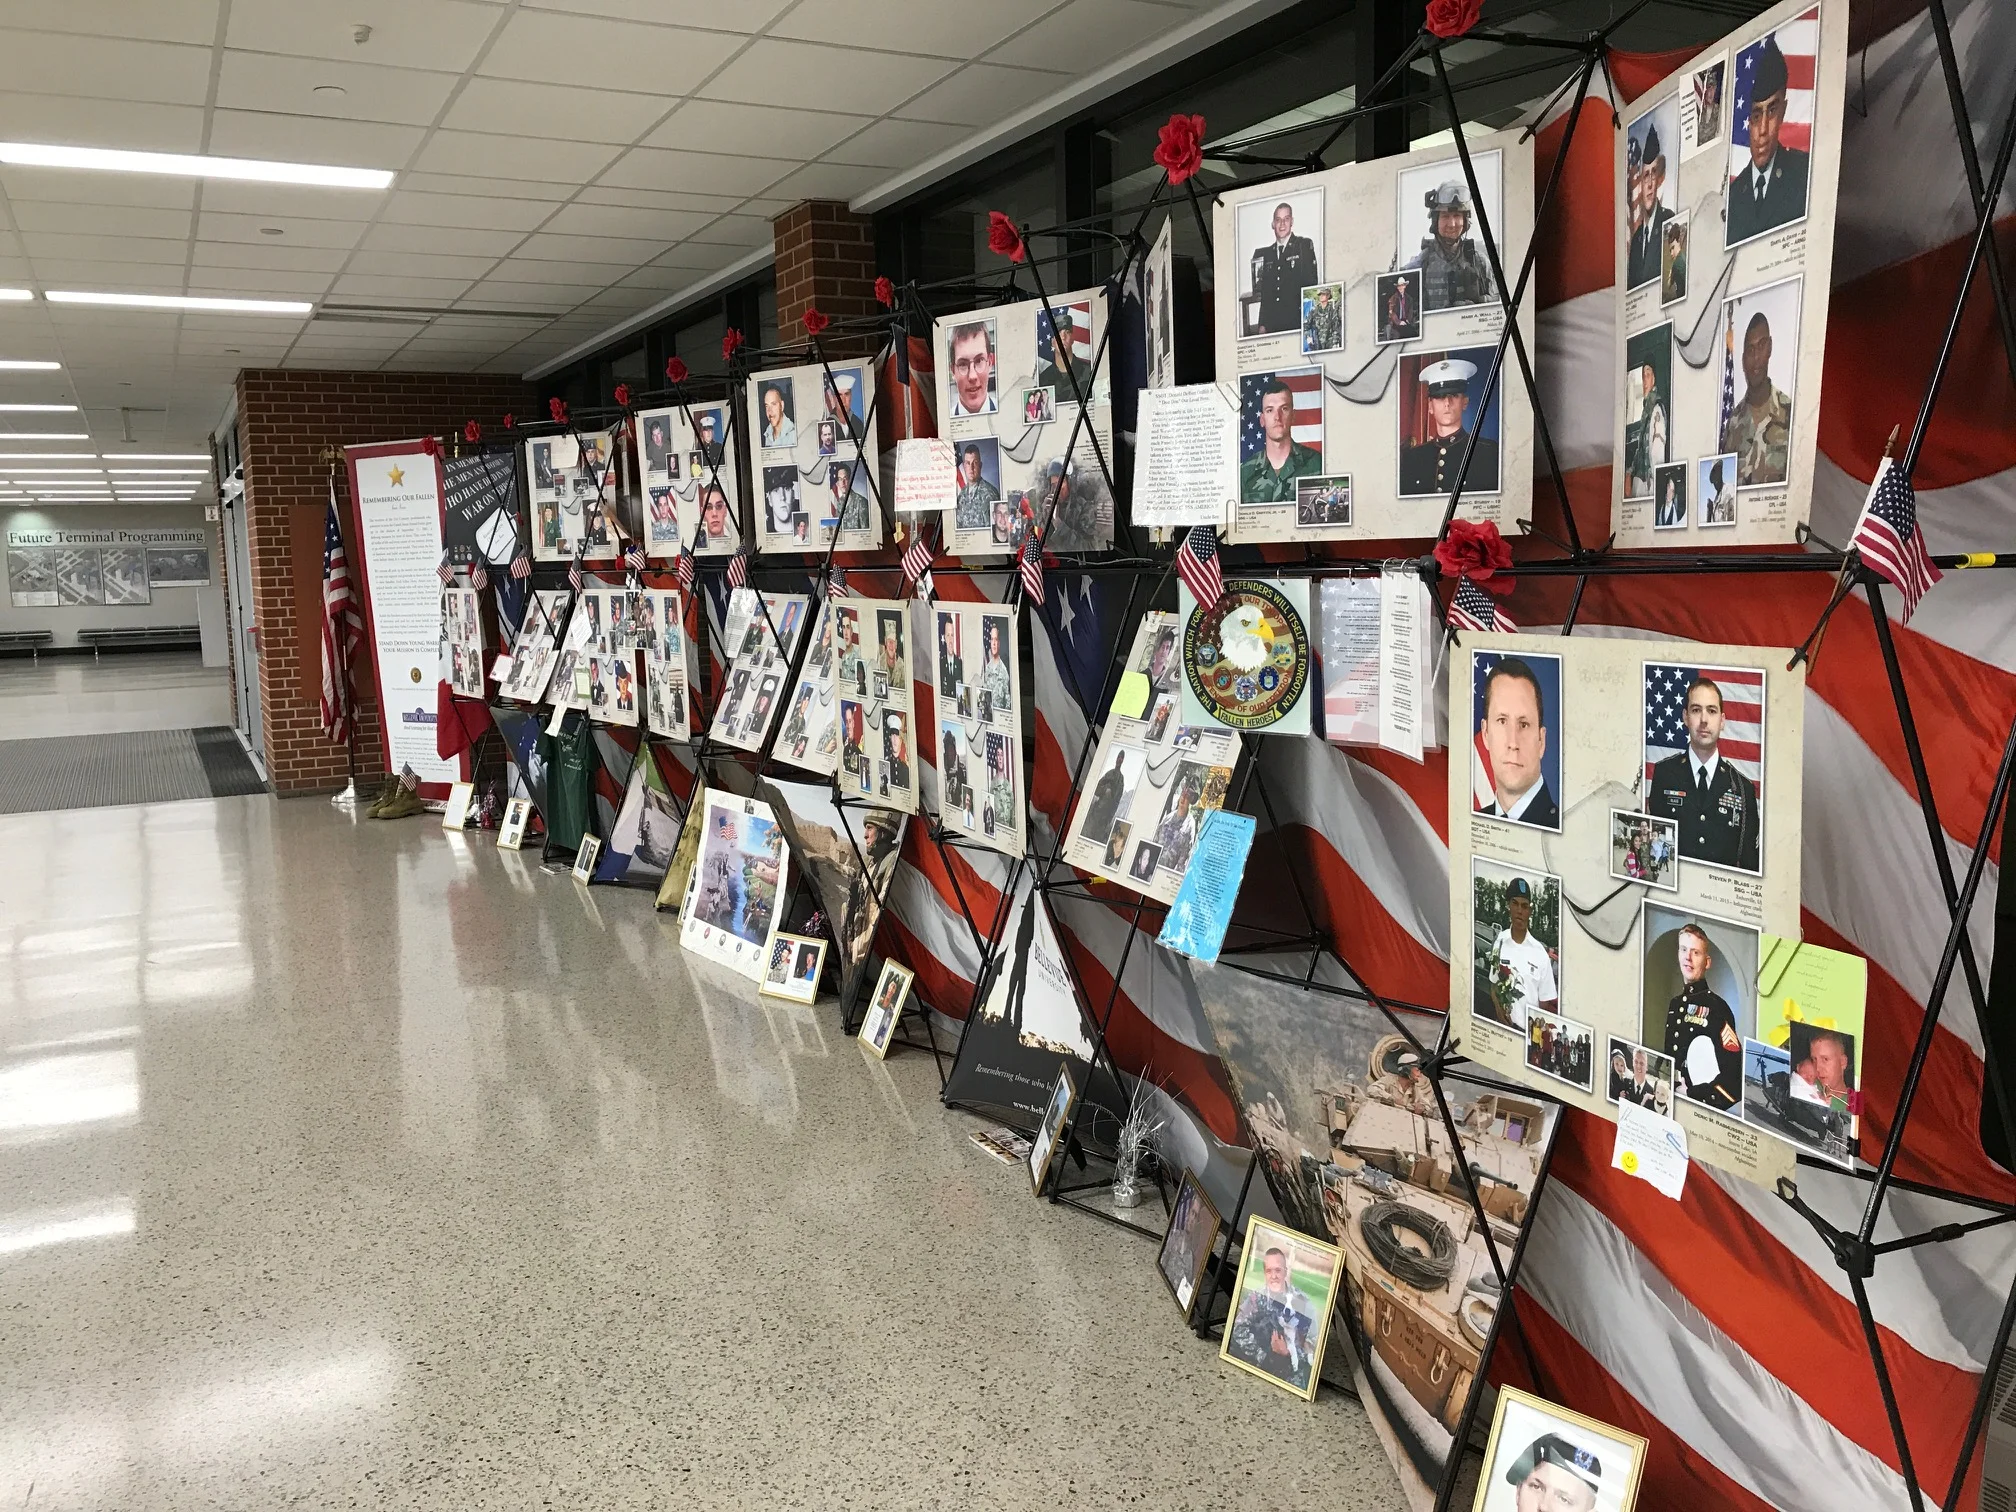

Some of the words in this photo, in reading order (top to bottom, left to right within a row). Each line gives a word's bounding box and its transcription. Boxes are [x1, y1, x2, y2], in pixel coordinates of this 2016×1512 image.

[445, 463, 456, 472] IN
[455, 455, 481, 469] MEMOR
[455, 470, 474, 484] MEN
[462, 480, 485, 499] HAVE
[482, 474, 497, 487] DID
[362, 496, 401, 504] REMEMBERING
[461, 499, 485, 521] WAR
[482, 491, 495, 506] ON
[9, 532, 52, 543] Future
[56, 531, 114, 543] Terminal
[119, 530, 204, 544] Programming
[1229, 581, 1273, 598] DEFENDERS
[1244, 595, 1260, 605] OUR
[1273, 593, 1289, 614] WILL
[1287, 613, 1305, 641] ITSELF
[1185, 629, 1195, 659] WHICH
[1298, 643, 1306, 655] BE
[1186, 661, 1203, 694] NATION
[1282, 658, 1306, 709] FORGOTTEN
[1200, 694, 1212, 709] THE
[1249, 702, 1265, 711] OUR
[1220, 713, 1244, 726] FALLEN
[1247, 714, 1274, 727] HEROES
[1708, 874, 1727, 883] STEVEN
[1733, 880, 1749, 888] BLASS
[1034, 942, 1067, 987] BELLEVUE
[975, 1063, 1014, 1081] Remembering
[1014, 1072, 1030, 1084] those
[1031, 1078, 1045, 1088] who
[1715, 1120, 1745, 1136] RASMUSSEN
[1727, 1132, 1740, 1141] CW2
[1745, 1139, 1757, 1148] USA
